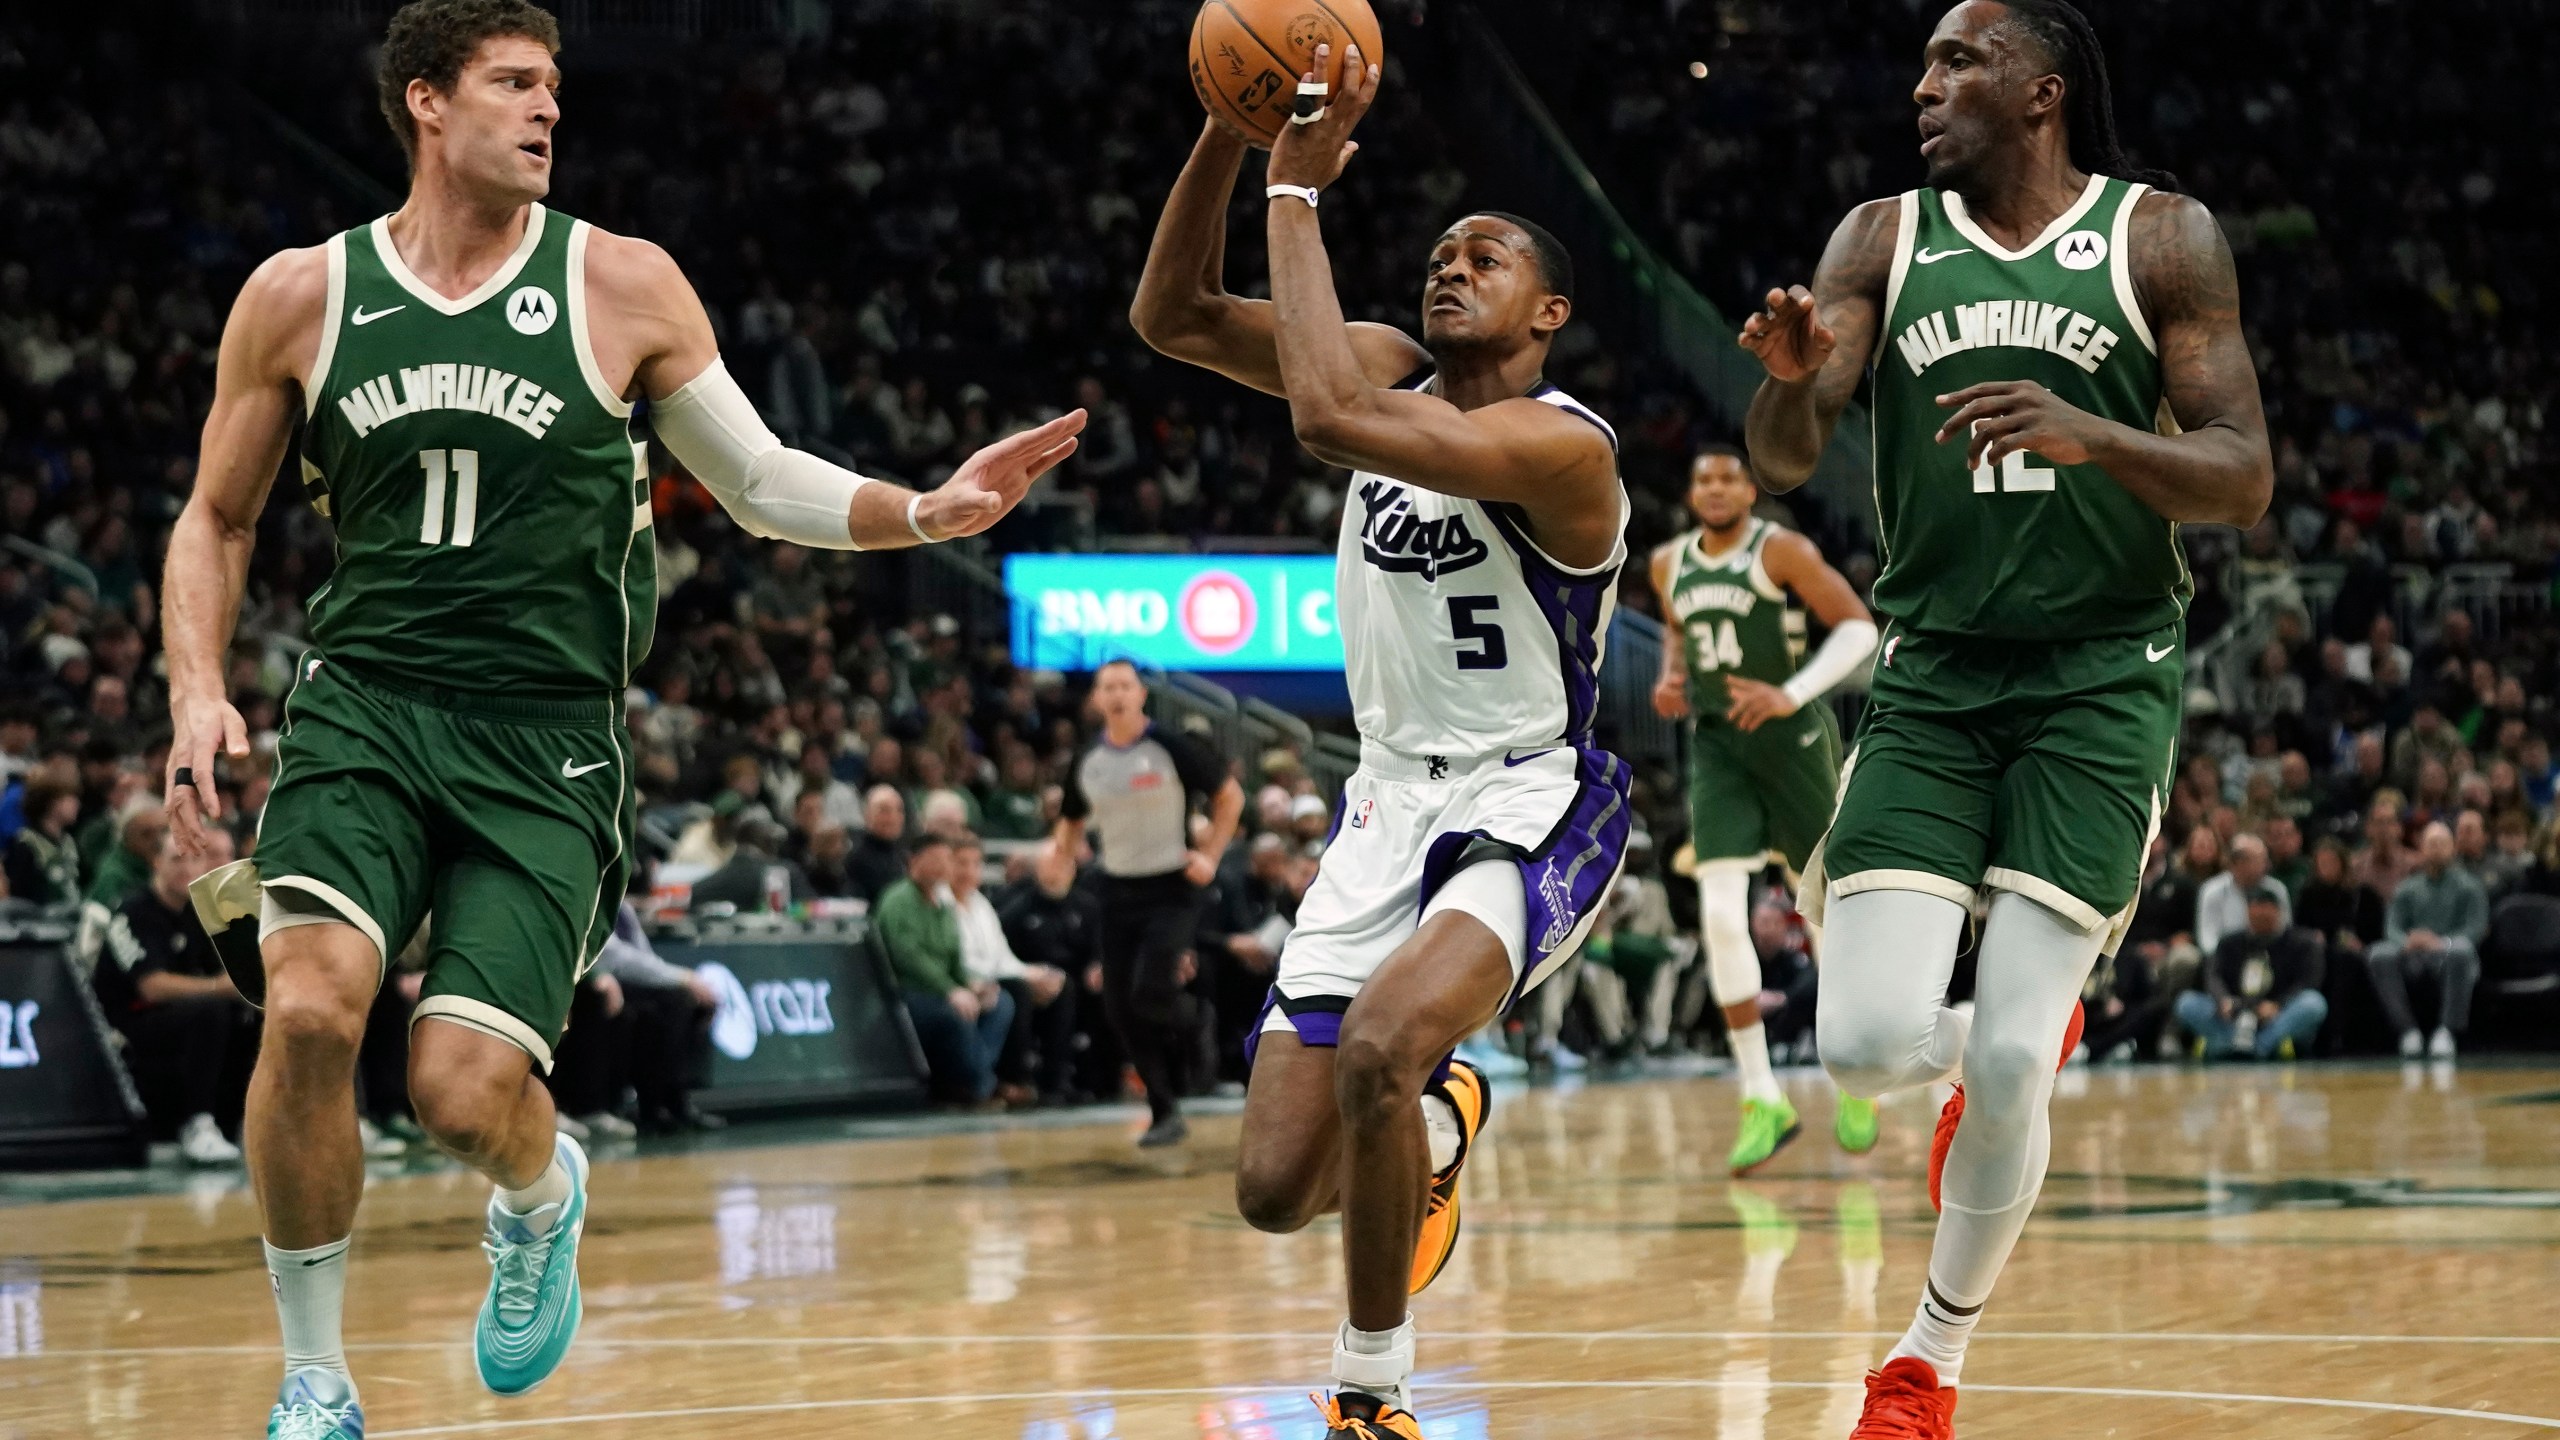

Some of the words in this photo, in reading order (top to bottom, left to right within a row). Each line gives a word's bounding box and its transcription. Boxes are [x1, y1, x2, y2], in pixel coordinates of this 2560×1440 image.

[1896, 300, 2120, 378] MILWAUKEE
[338, 363, 565, 439] MILWAUKEE
[419, 449, 479, 547] 11
[1359, 480, 1488, 583] Kings
[1042, 588, 1169, 636] BMO
[1447, 594, 1508, 670] 5
[1689, 619, 1744, 672] 34
[753, 979, 835, 1035] razr
